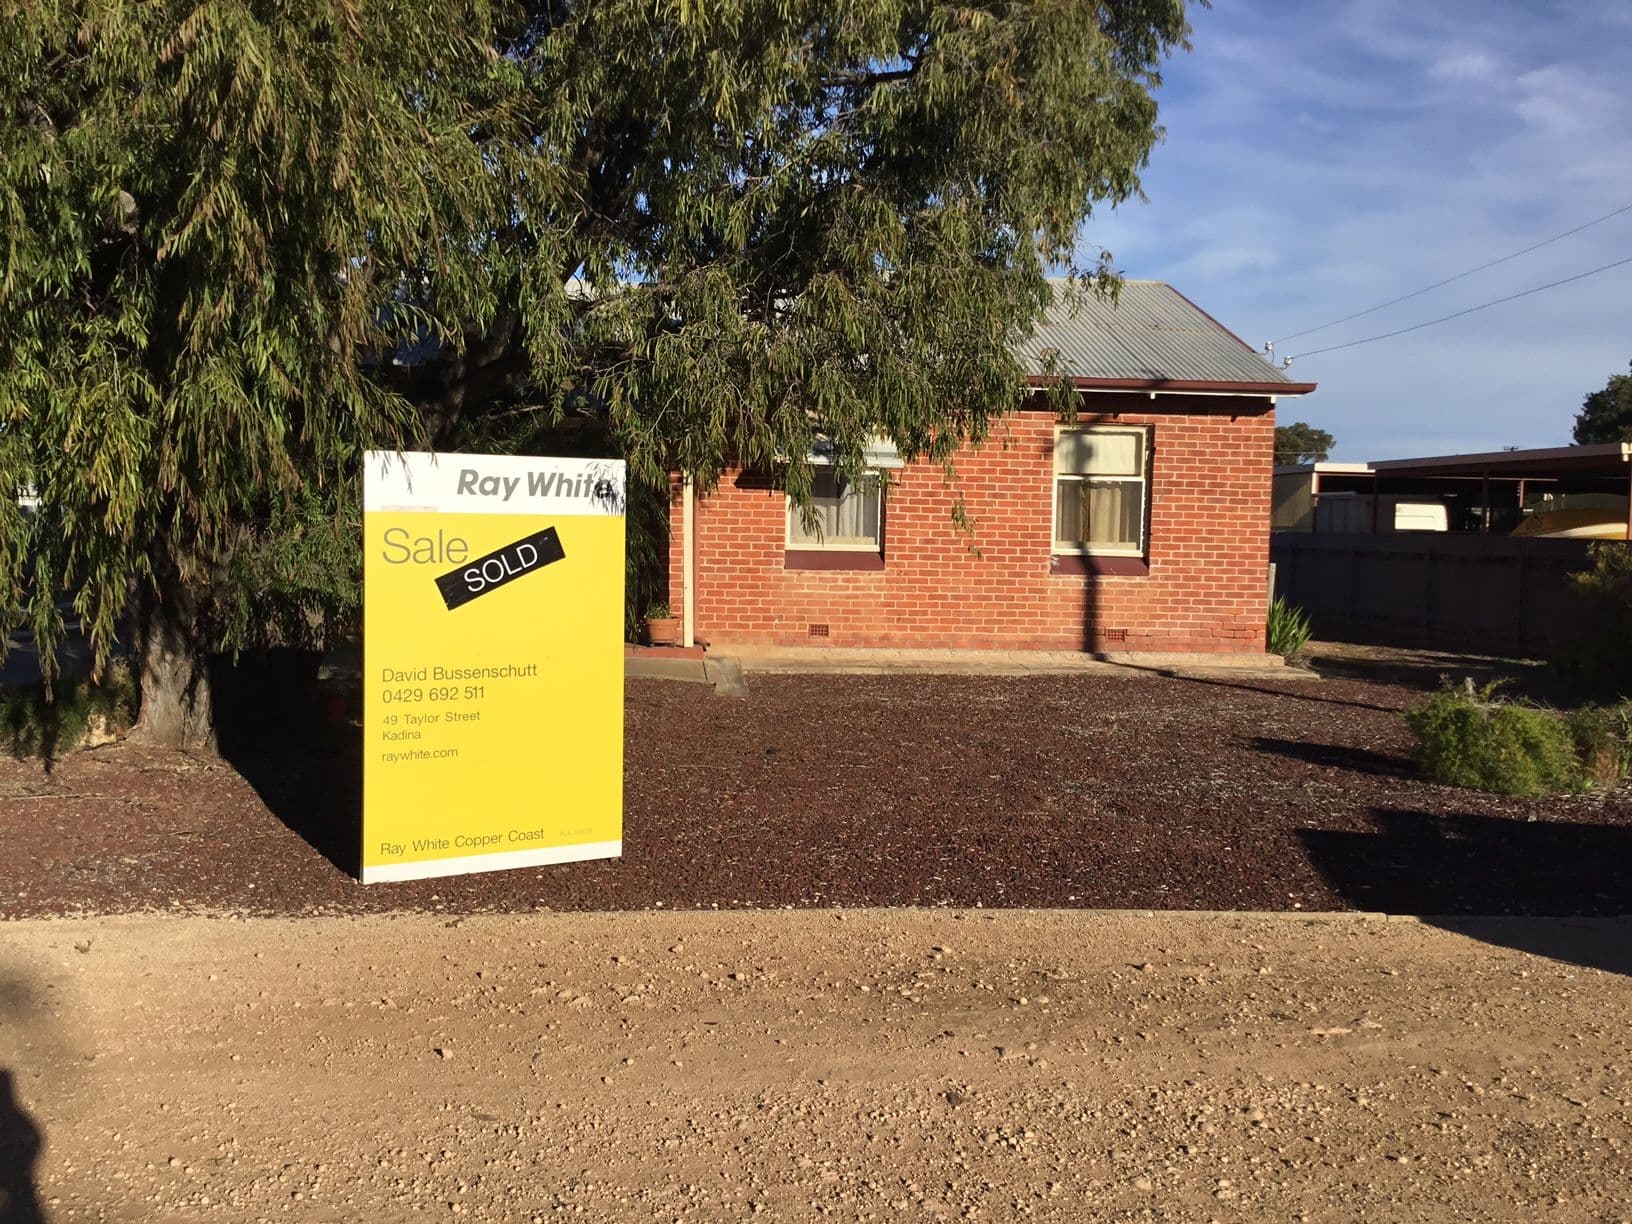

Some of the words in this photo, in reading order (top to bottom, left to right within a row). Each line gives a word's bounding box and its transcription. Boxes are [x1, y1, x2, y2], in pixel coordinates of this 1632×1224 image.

[457, 469, 520, 502] Ray
[528, 471, 612, 499] White
[382, 527, 469, 565] Sale
[464, 543, 538, 593] SOLD
[382, 667, 427, 683] David
[433, 663, 537, 681] Bussenschutt
[382, 688, 424, 704] 0429
[428, 686, 458, 702] 692
[464, 685, 485, 700] 511
[383, 714, 398, 726] 49
[403, 712, 439, 727] Taylor
[445, 711, 480, 723] Street
[382, 729, 421, 742] Kadina
[382, 747, 458, 763] raywhite.com
[380, 842, 406, 857] Ray
[412, 838, 449, 852] White
[454, 832, 503, 850] Copper
[508, 827, 544, 843] Coast
